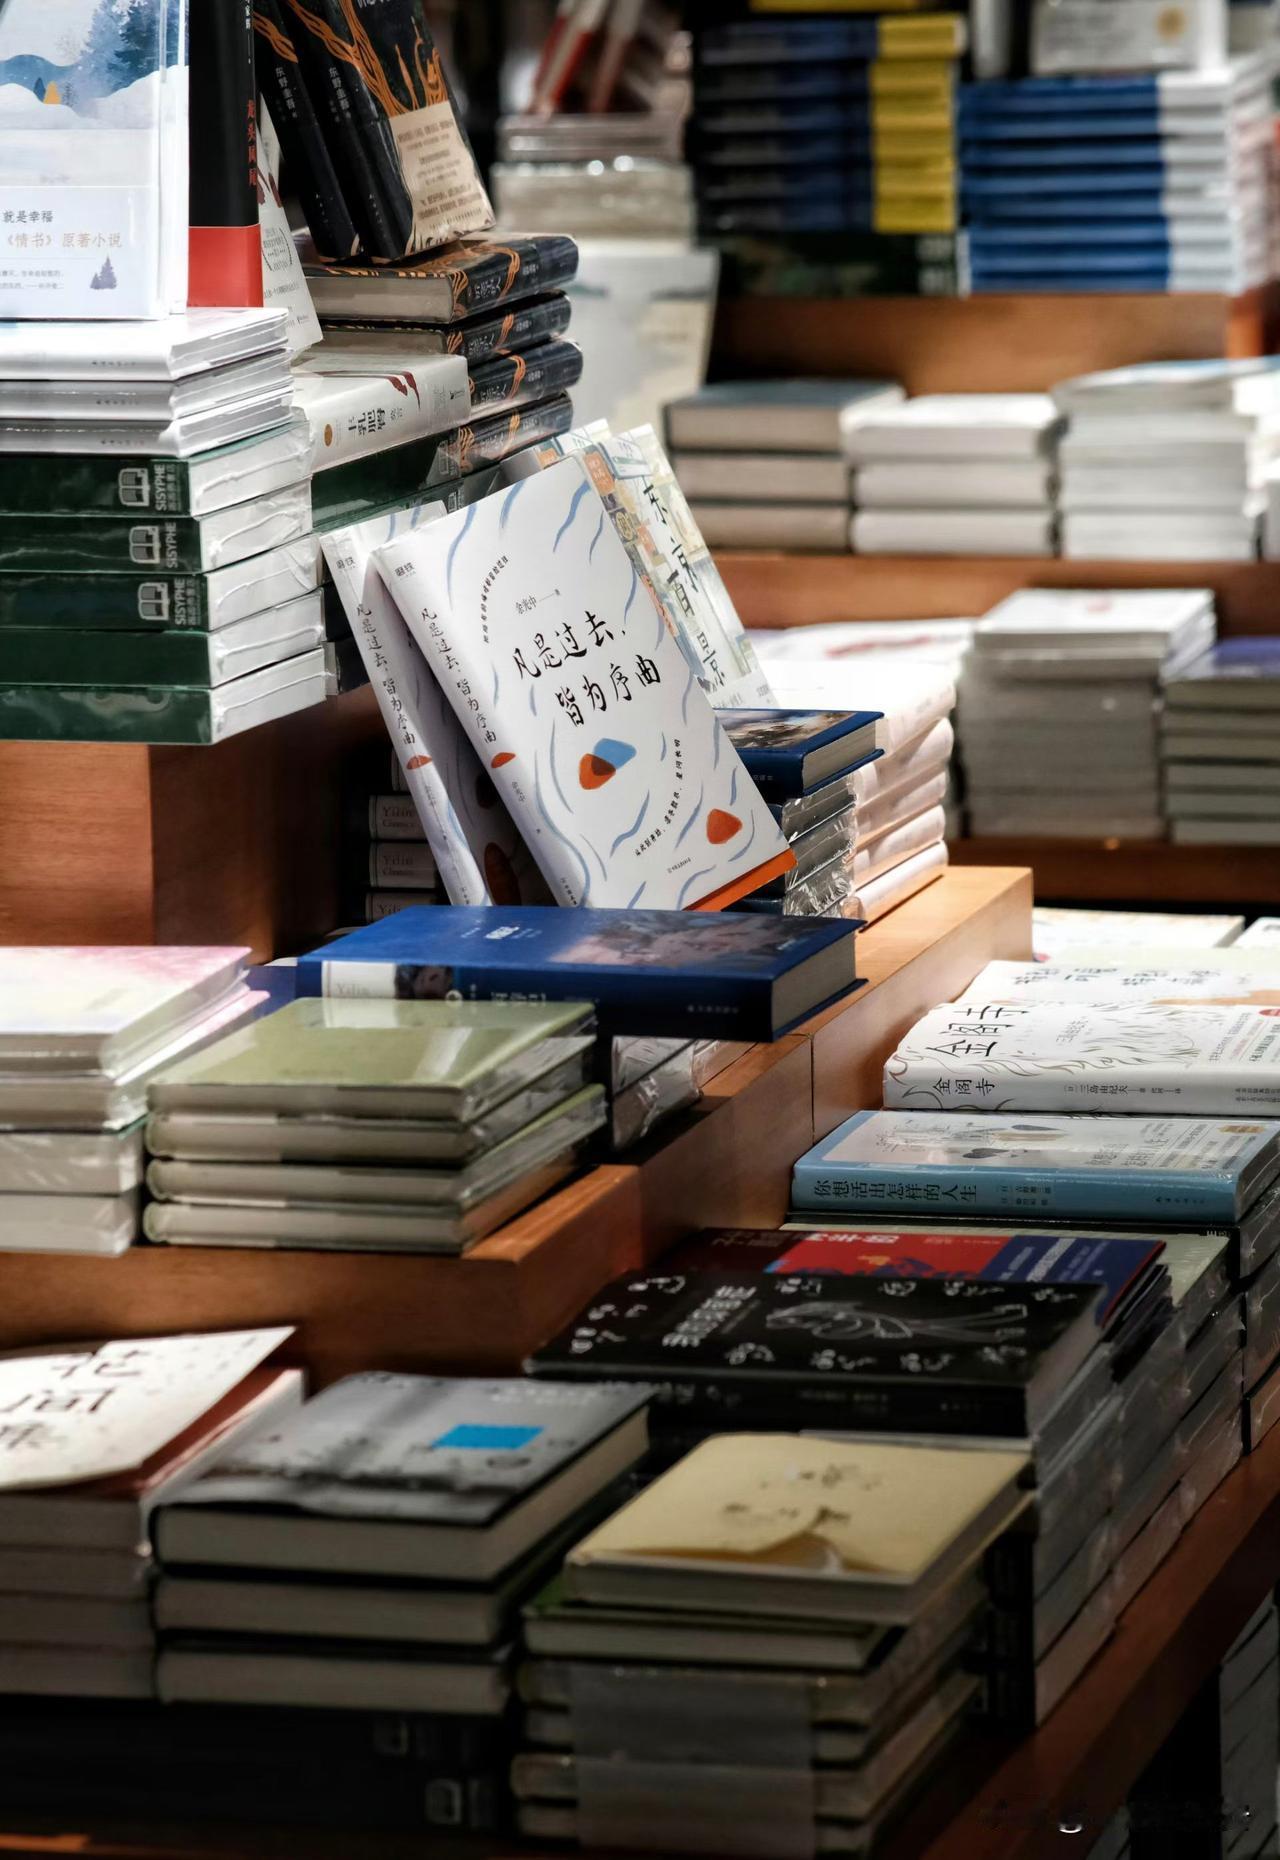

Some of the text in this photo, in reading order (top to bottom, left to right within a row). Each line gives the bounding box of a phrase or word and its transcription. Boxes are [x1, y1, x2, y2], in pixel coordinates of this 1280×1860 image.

[3, 210, 54, 223] 就是幸福
[7, 233, 122, 248] 《情书》原著小说
[555, 654, 662, 727] 皆为序曲
[925, 1005, 1029, 1058] 金阁寺
[932, 1077, 996, 1095] 金阁寺
[813, 1179, 977, 1202] 你想活出怎样的人生
